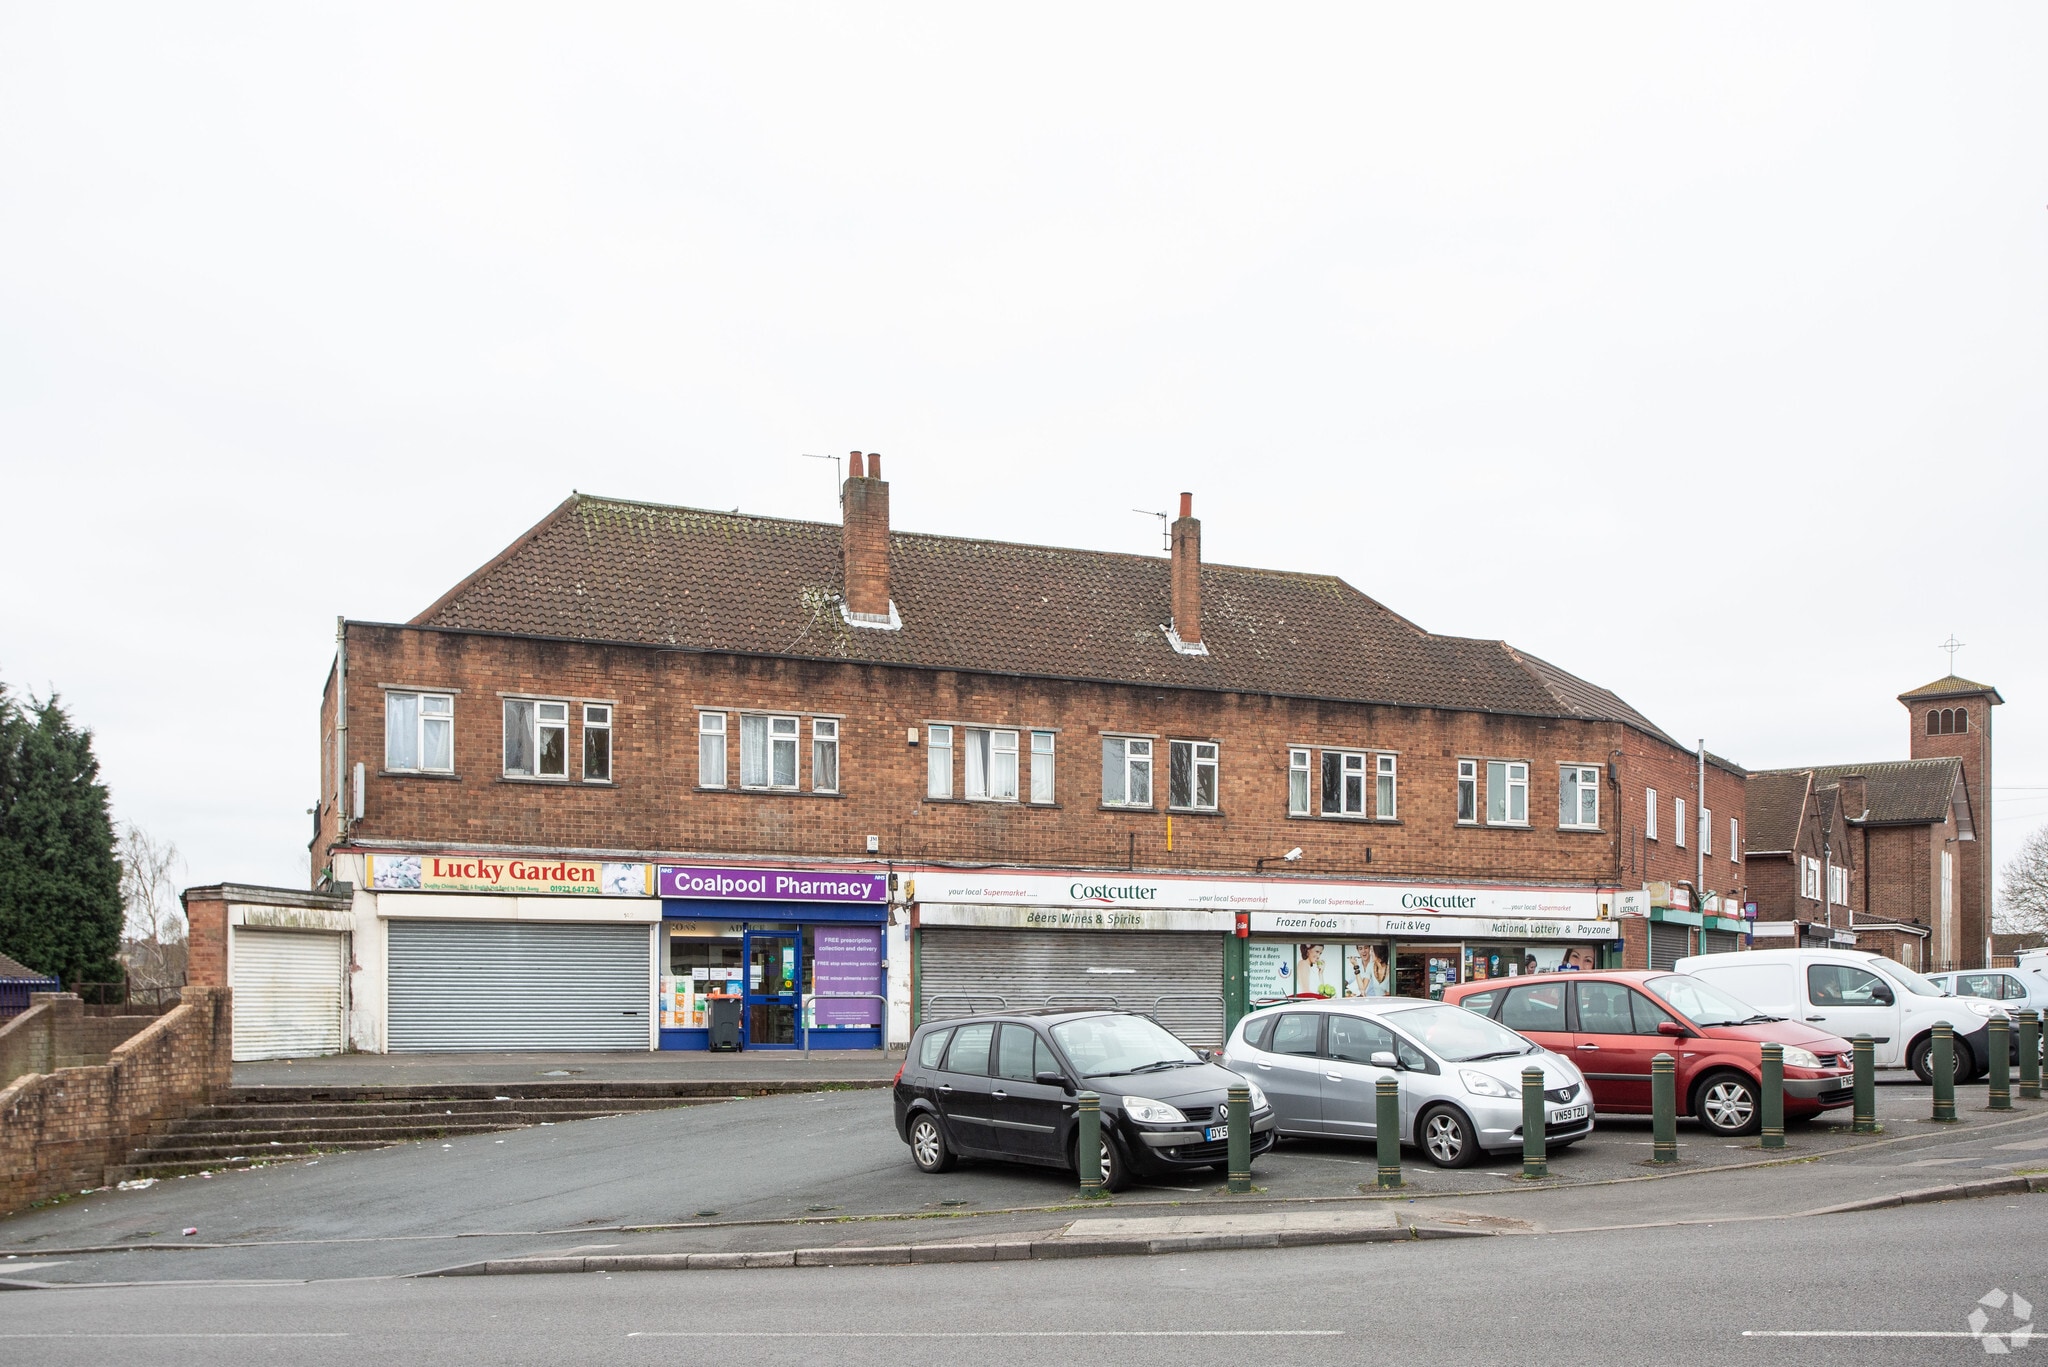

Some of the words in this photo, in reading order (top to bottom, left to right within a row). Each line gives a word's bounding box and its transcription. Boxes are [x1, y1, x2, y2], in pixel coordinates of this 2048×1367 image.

[433, 858, 503, 884] Lucky
[509, 861, 595, 882] Garden
[550, 885, 570, 893] 01922
[573, 885, 584, 893] 647
[675, 873, 765, 896] Coalpool
[776, 877, 872, 899] Pharmacy
[1070, 883, 1157, 900] Costcutter
[1402, 893, 1476, 909] Costcutter
[1538, 904, 1571, 912] Supermarket
[1620, 905, 1639, 913] LICENCE
[1027, 912, 1057, 923] Beers
[1061, 913, 1093, 924] Wines
[1095, 914, 1103, 923] &
[1107, 914, 1141, 926] Spirits
[1276, 917, 1307, 928] Frozen
[1309, 918, 1337, 928] Foods
[672, 923, 696, 932] ONS
[729, 924, 766, 933] ADICE
[1386, 920, 1406, 930] Fruit
[1407, 921, 1414, 930] &
[1415, 921, 1431, 932] Veg
[1491, 923, 1528, 934] National
[1530, 924, 1561, 936] Lottery
[1565, 925, 1572, 934] &
[1577, 925, 1612, 936] Payzone
[856, 945, 877, 953] delivery
[1554, 1109, 1572, 1121] VN59
[1573, 1107, 1585, 1118] TZU
[1211, 1126, 1228, 1139] DY5
